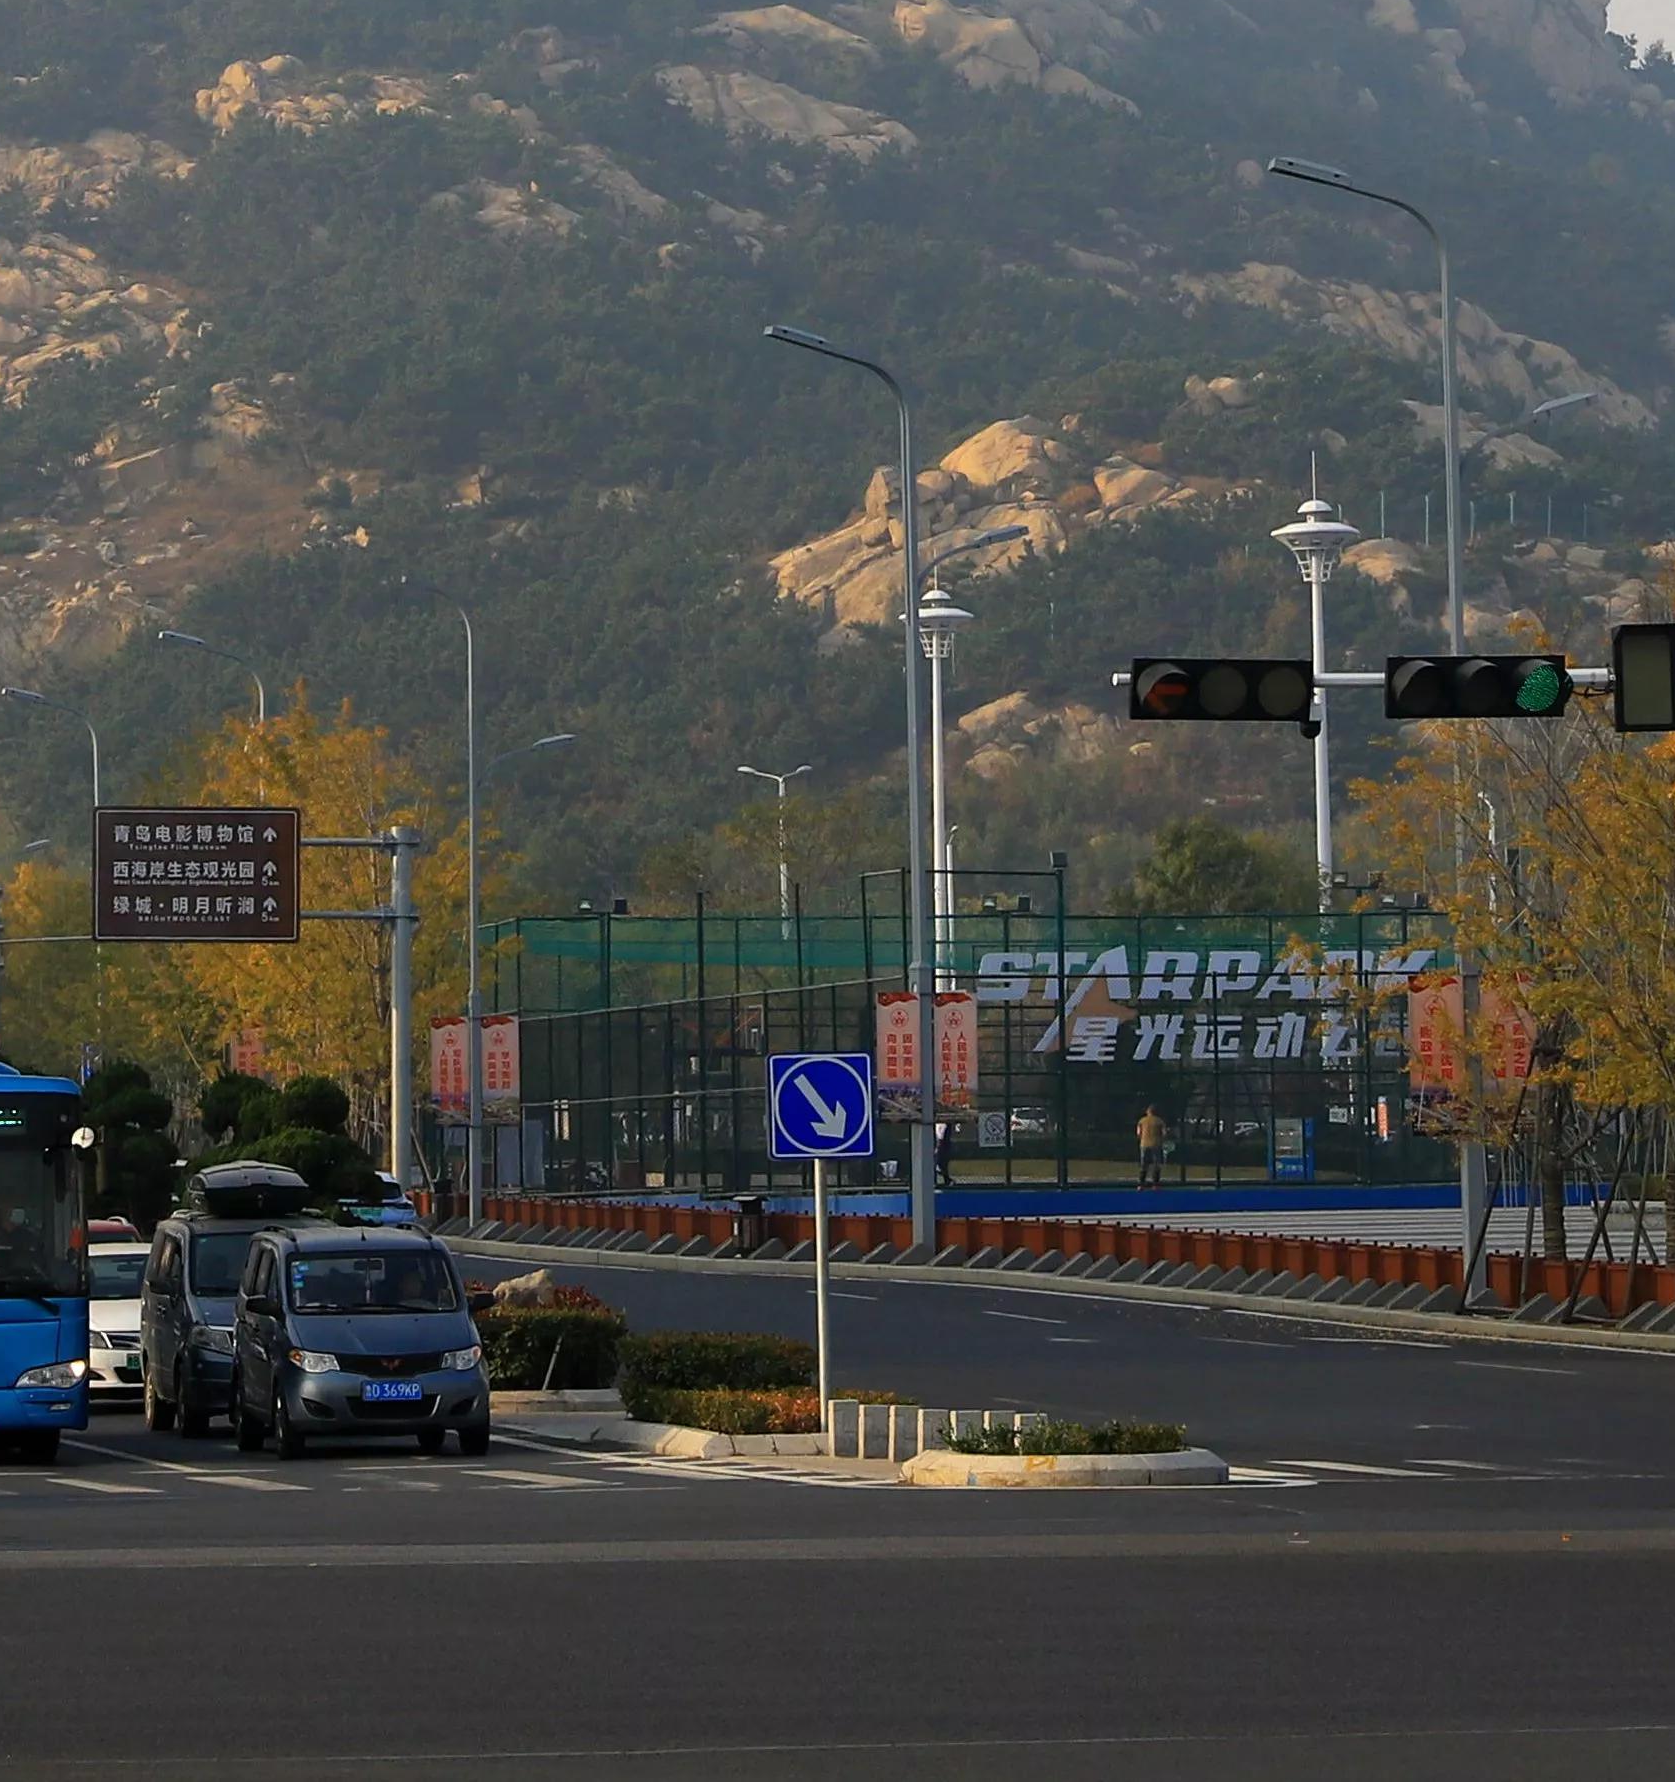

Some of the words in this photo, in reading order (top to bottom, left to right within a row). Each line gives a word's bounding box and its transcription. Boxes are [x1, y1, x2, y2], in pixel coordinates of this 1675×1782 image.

[114, 825, 254, 843] 青岛电影博物馆
[113, 861, 254, 878] 西海岸生态观光园
